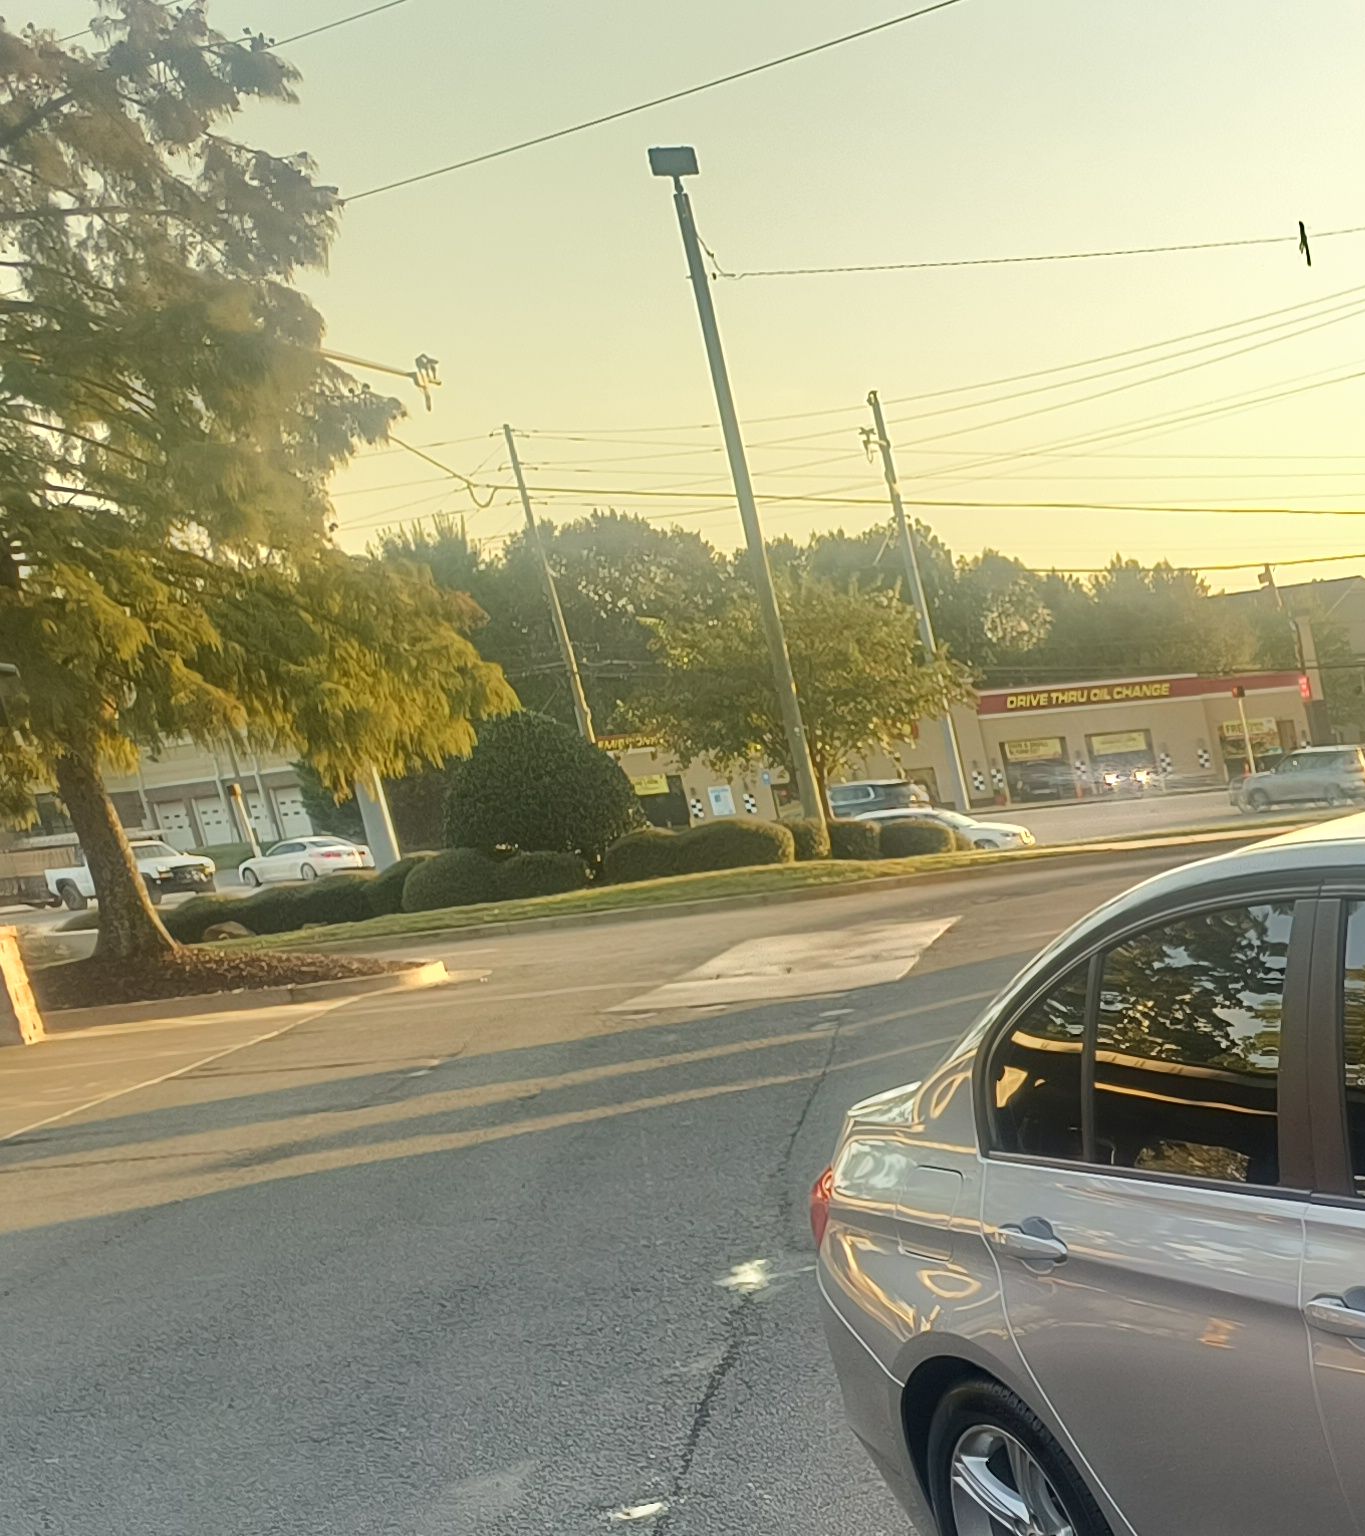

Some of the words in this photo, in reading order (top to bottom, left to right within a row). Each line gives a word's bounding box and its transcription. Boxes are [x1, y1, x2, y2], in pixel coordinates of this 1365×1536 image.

[1006, 692, 1049, 709] DRIVE
[1050, 690, 1088, 705] THRU
[1089, 688, 1112, 702] OIL
[1112, 683, 1171, 699] CHANGE
